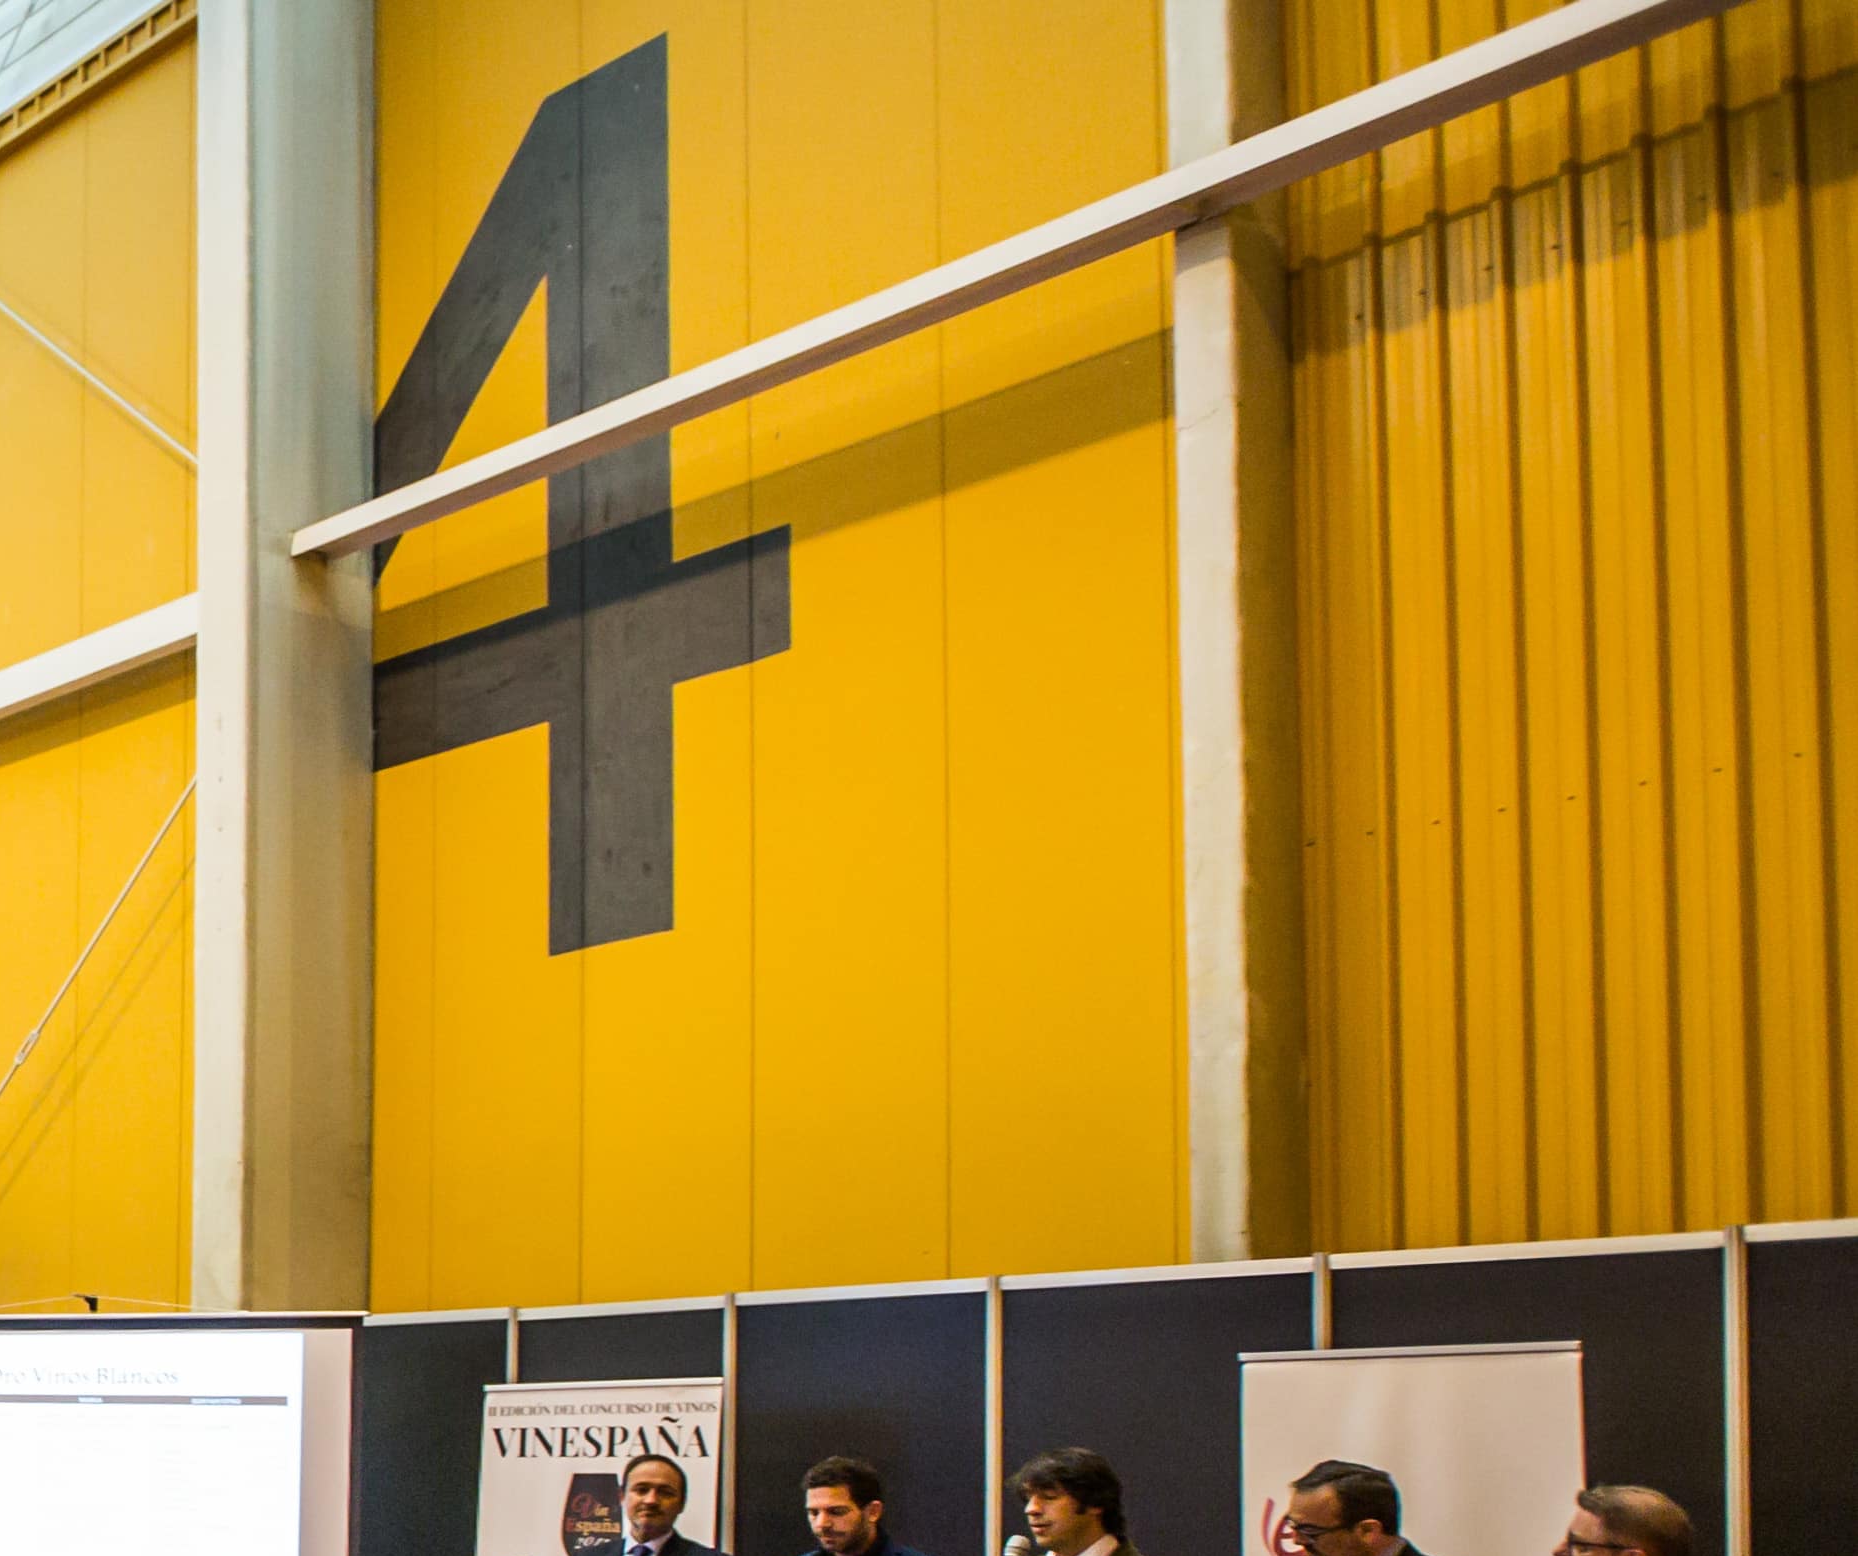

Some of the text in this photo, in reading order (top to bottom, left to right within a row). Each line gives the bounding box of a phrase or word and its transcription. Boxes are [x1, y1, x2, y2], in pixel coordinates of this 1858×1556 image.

[372, 31, 792, 956] 4
[554, 1403, 577, 1416] DEL
[580, 1402, 652, 1415] CONCURSO
[655, 1402, 673, 1414] DE
[675, 1401, 718, 1413] VINOS
[491, 1416, 710, 1458] VINESPAÑA
